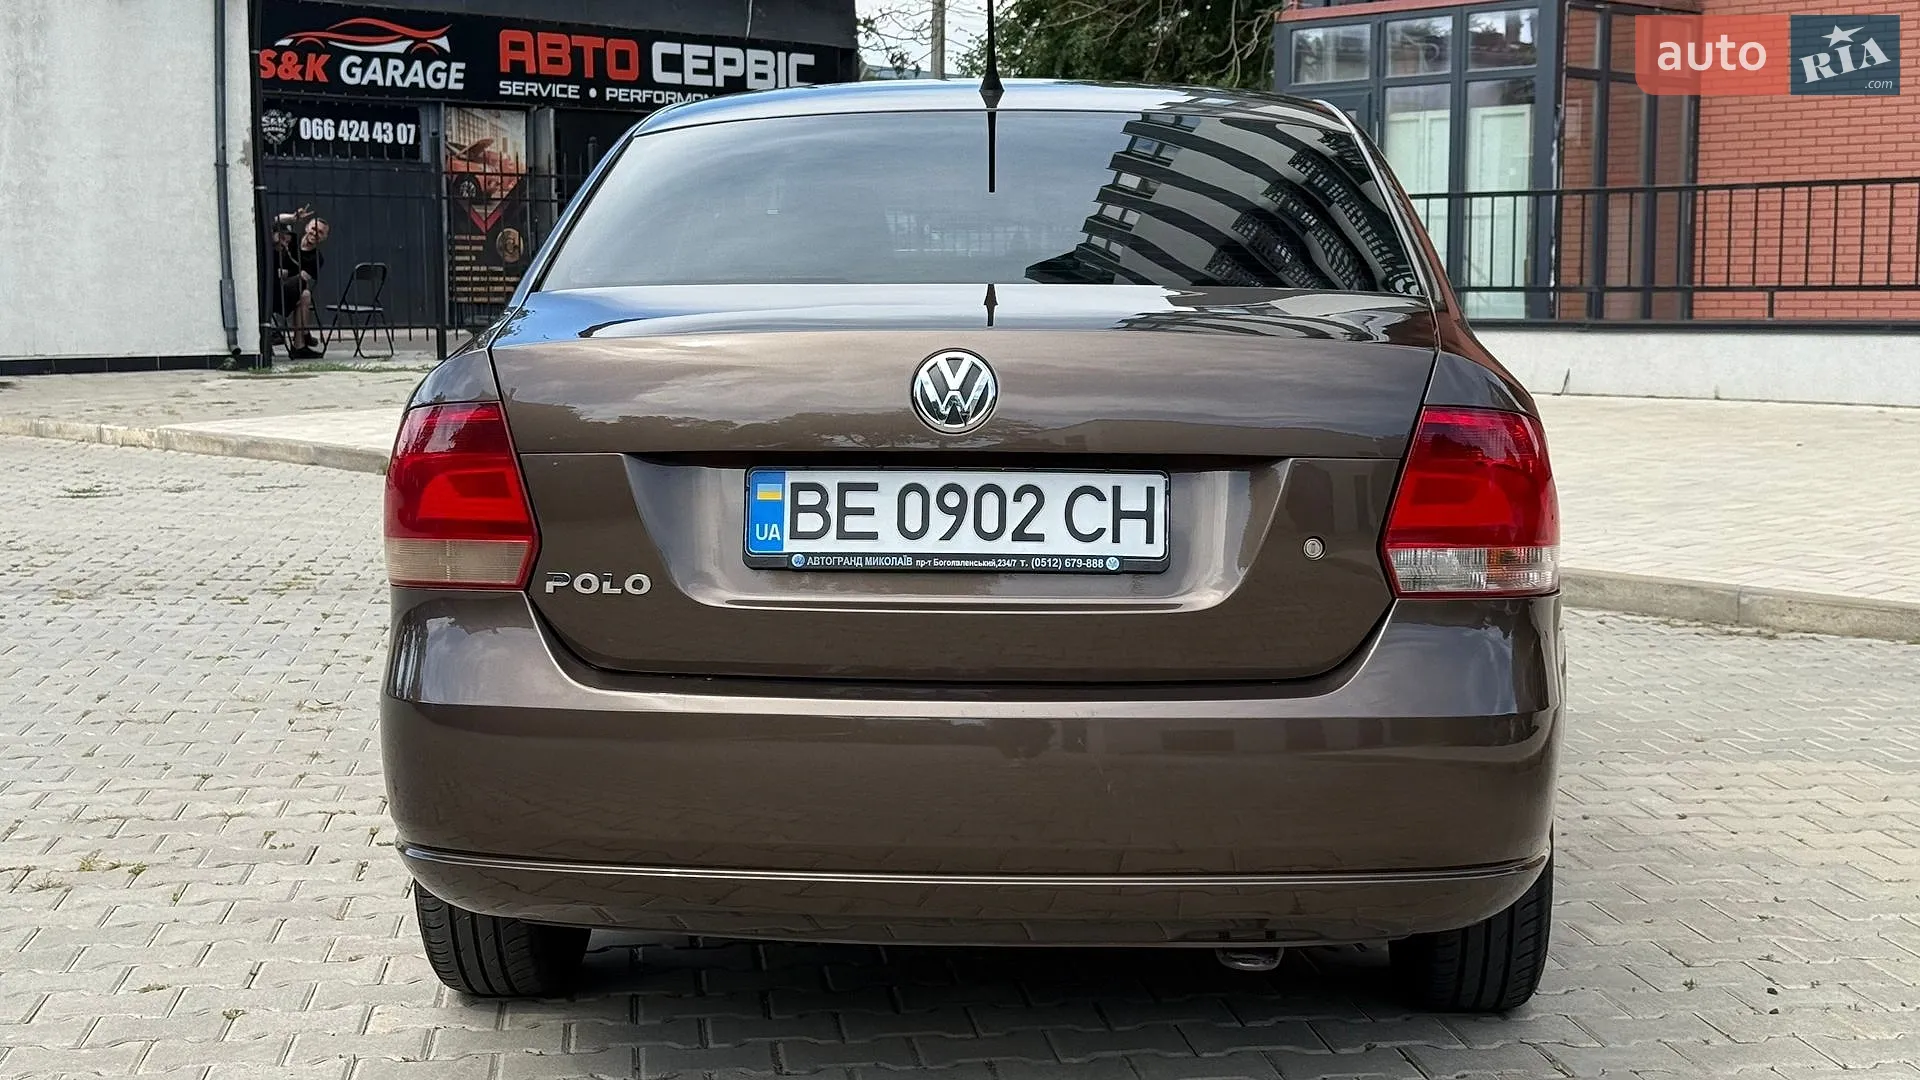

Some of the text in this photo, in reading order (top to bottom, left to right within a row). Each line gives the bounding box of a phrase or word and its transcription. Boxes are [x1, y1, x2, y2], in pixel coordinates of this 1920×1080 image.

[259, 48, 466, 90] S&K GARAGE
[499, 29, 815, 90] АВТО СЕРВІС
[499, 80, 580, 99] SERVICE
[300, 117, 416, 145] 066 424 43 07
[789, 482, 1155, 545] BE 0902 CH
[755, 523, 781, 542] UA
[806, 556, 864, 567] АВТОГРАНД
[864, 555, 913, 566] МИКОЛАЇВ
[1031, 557, 1062, 570] (0512)
[1064, 558, 1104, 569] 679-888
[545, 572, 652, 595] POLO
